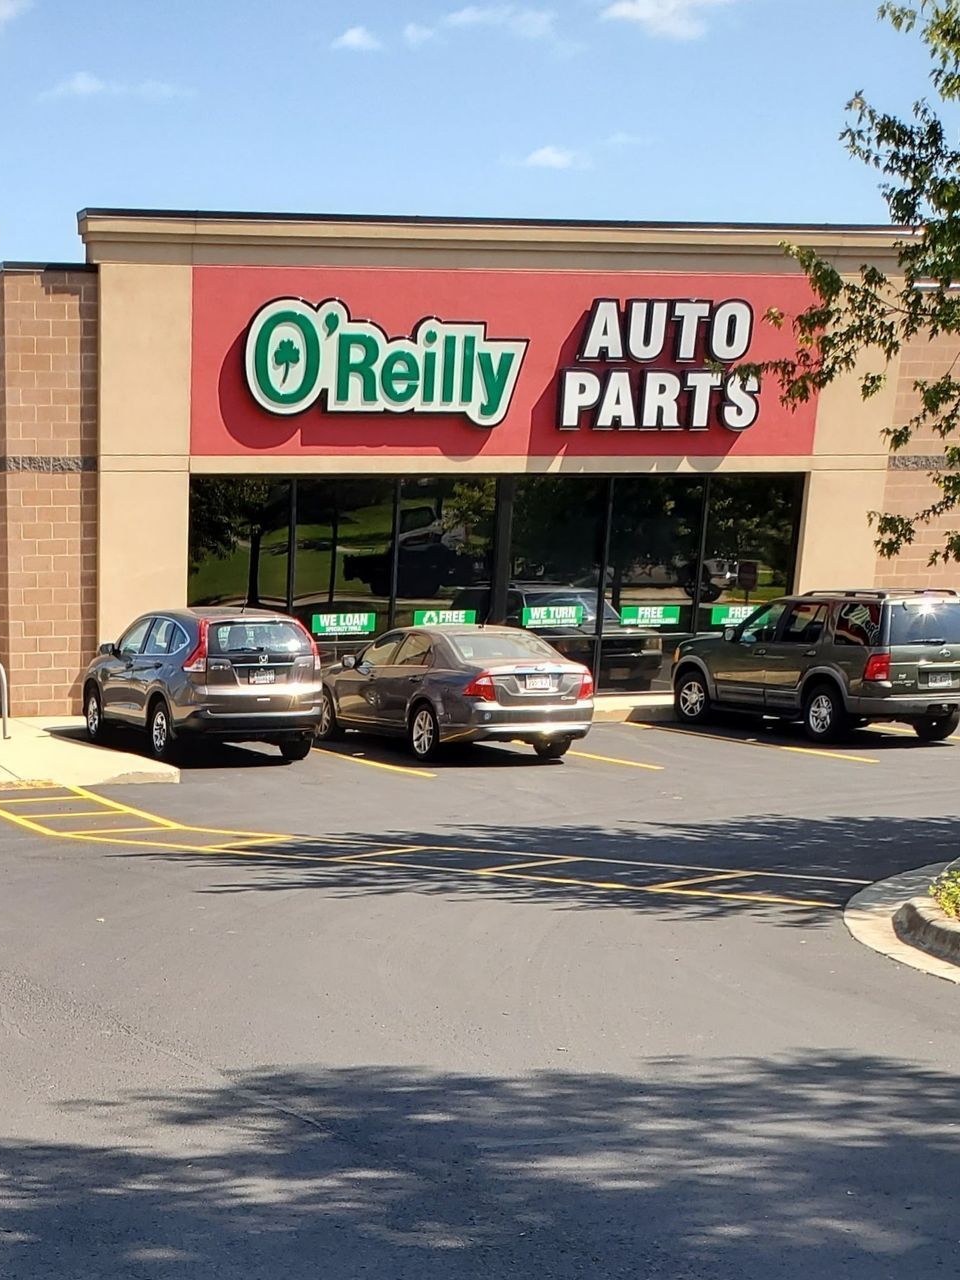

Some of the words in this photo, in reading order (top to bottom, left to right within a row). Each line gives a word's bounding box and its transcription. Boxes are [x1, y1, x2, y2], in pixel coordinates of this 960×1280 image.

[582, 300, 753, 361] AUTO
[252, 308, 518, 418] O'Reilly
[560, 370, 759, 429] PARTS
[439, 611, 466, 623] FREE
[530, 607, 548, 620] WE
[549, 606, 577, 619] TURN
[638, 606, 664, 619] FREE
[728, 606, 754, 619] FREE
[319, 614, 337, 627] WE
[339, 613, 369, 627] LOAN
